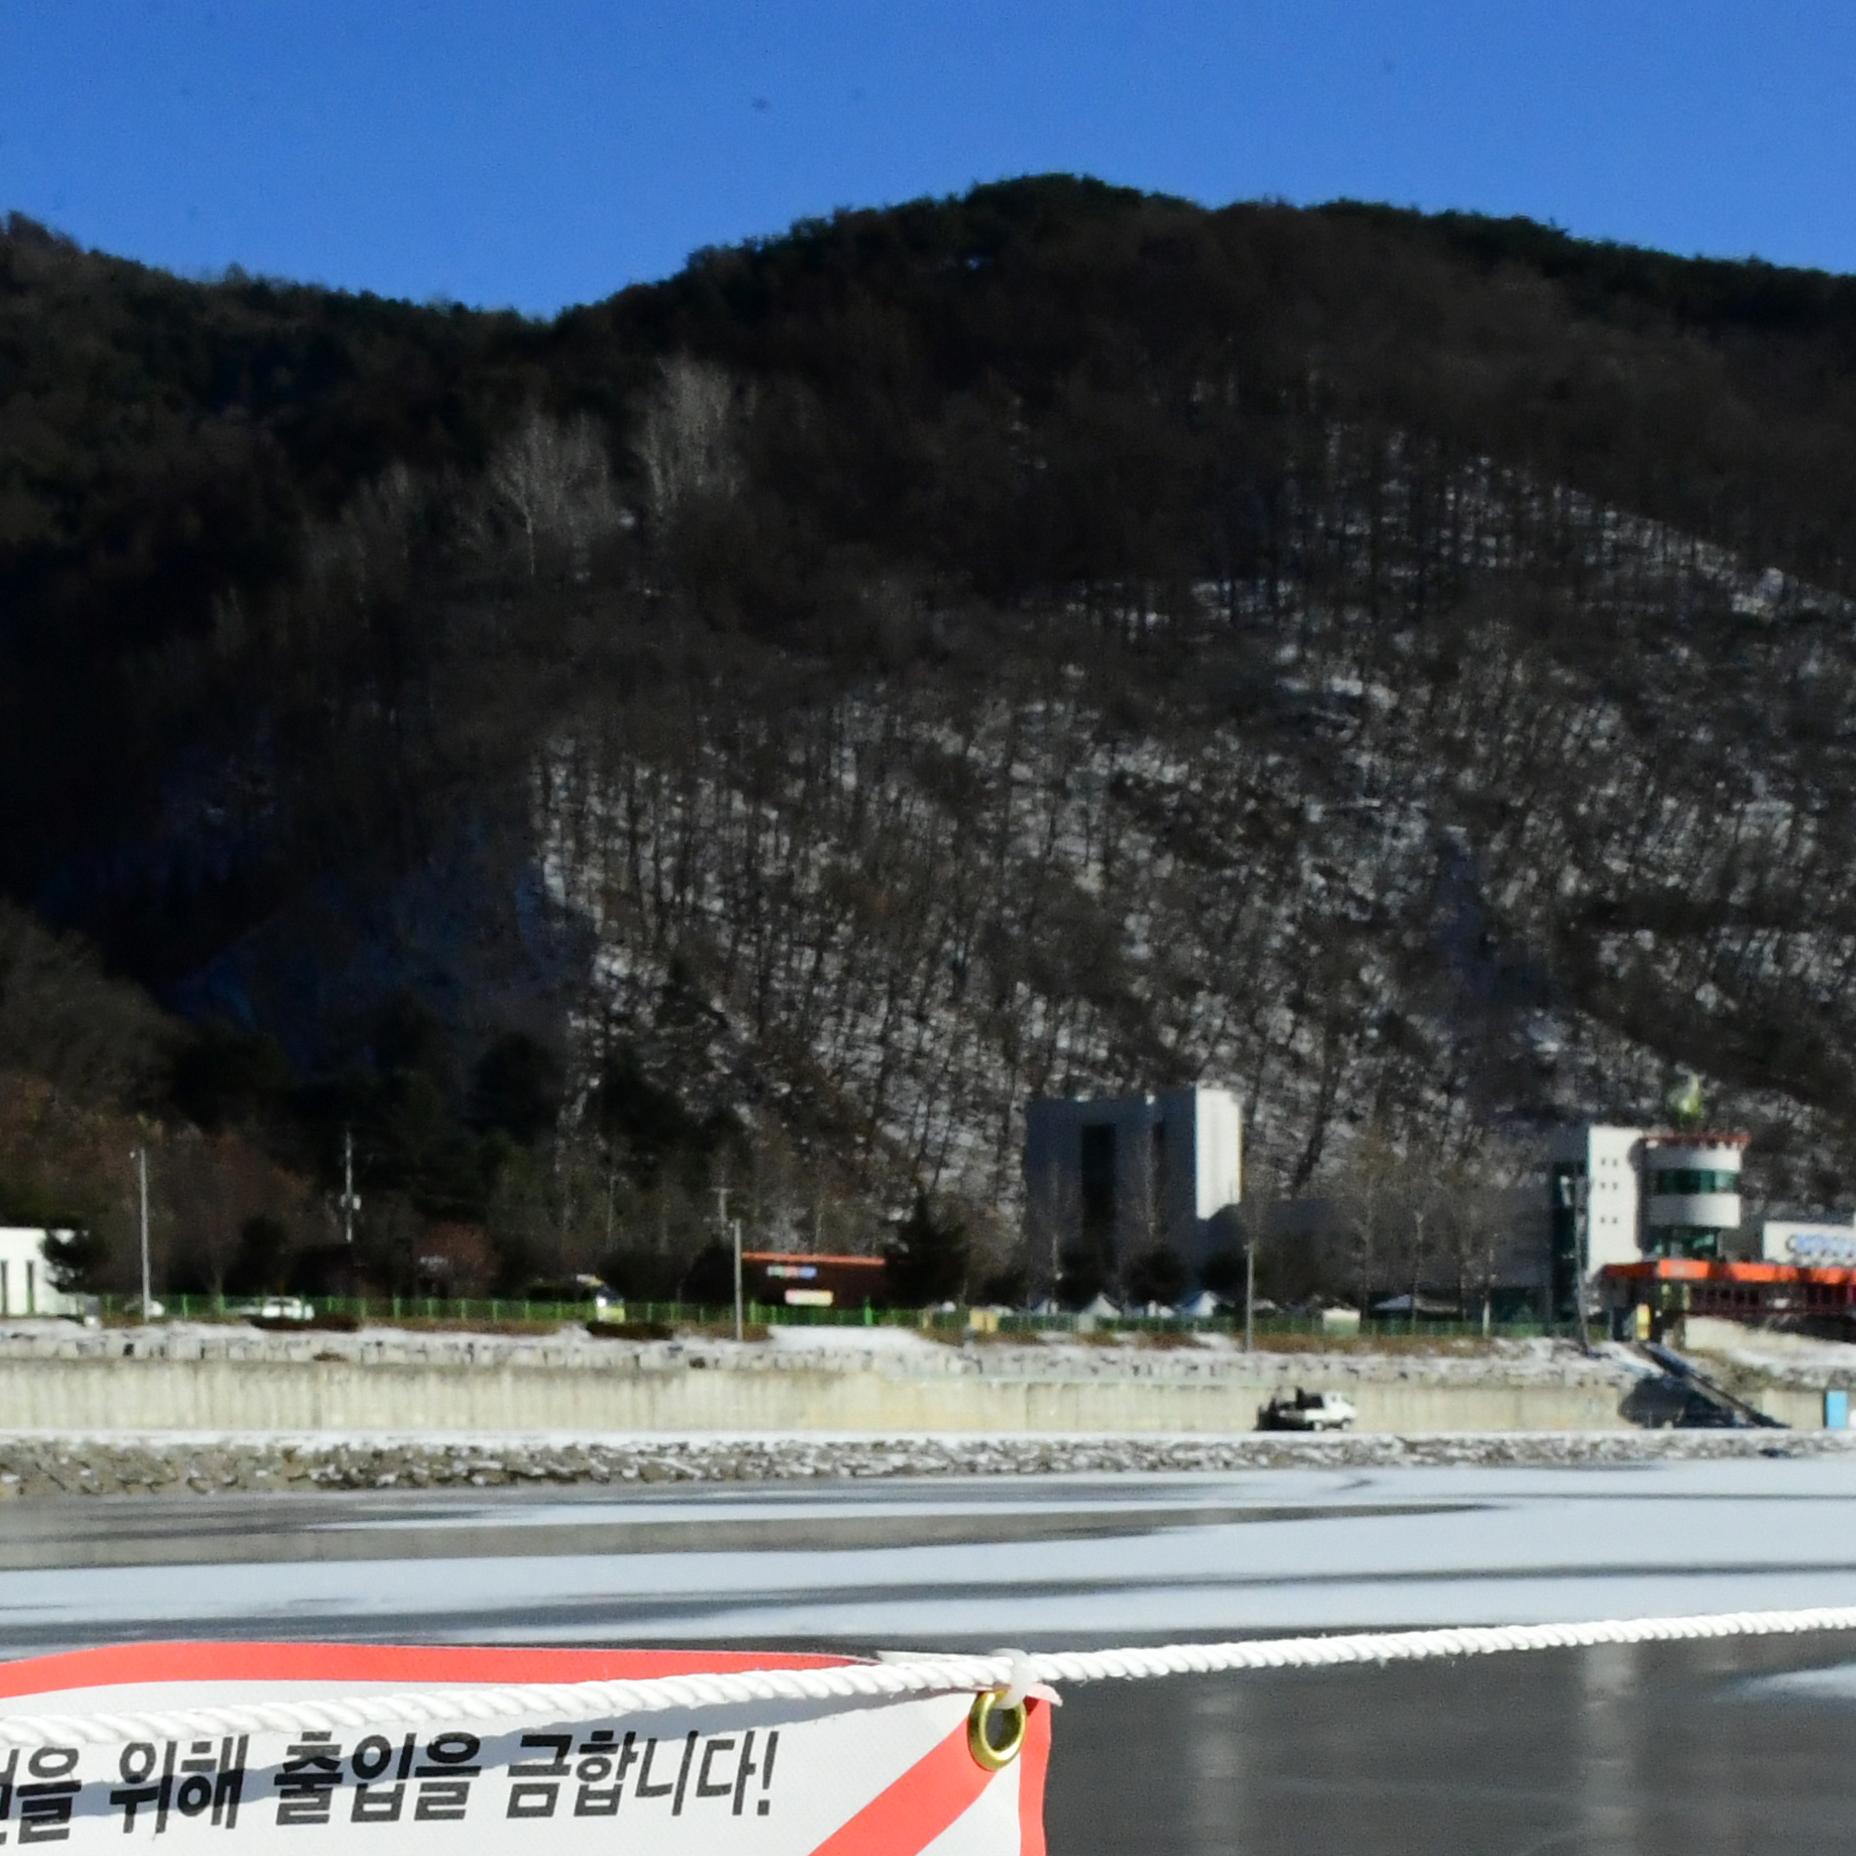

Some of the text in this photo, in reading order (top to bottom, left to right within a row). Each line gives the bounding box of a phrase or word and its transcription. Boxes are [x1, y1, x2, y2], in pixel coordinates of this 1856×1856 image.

[106, 1734, 249, 1835] 위해
[272, 1731, 484, 1826] 출입을
[506, 1728, 780, 1819] 금합니다!
